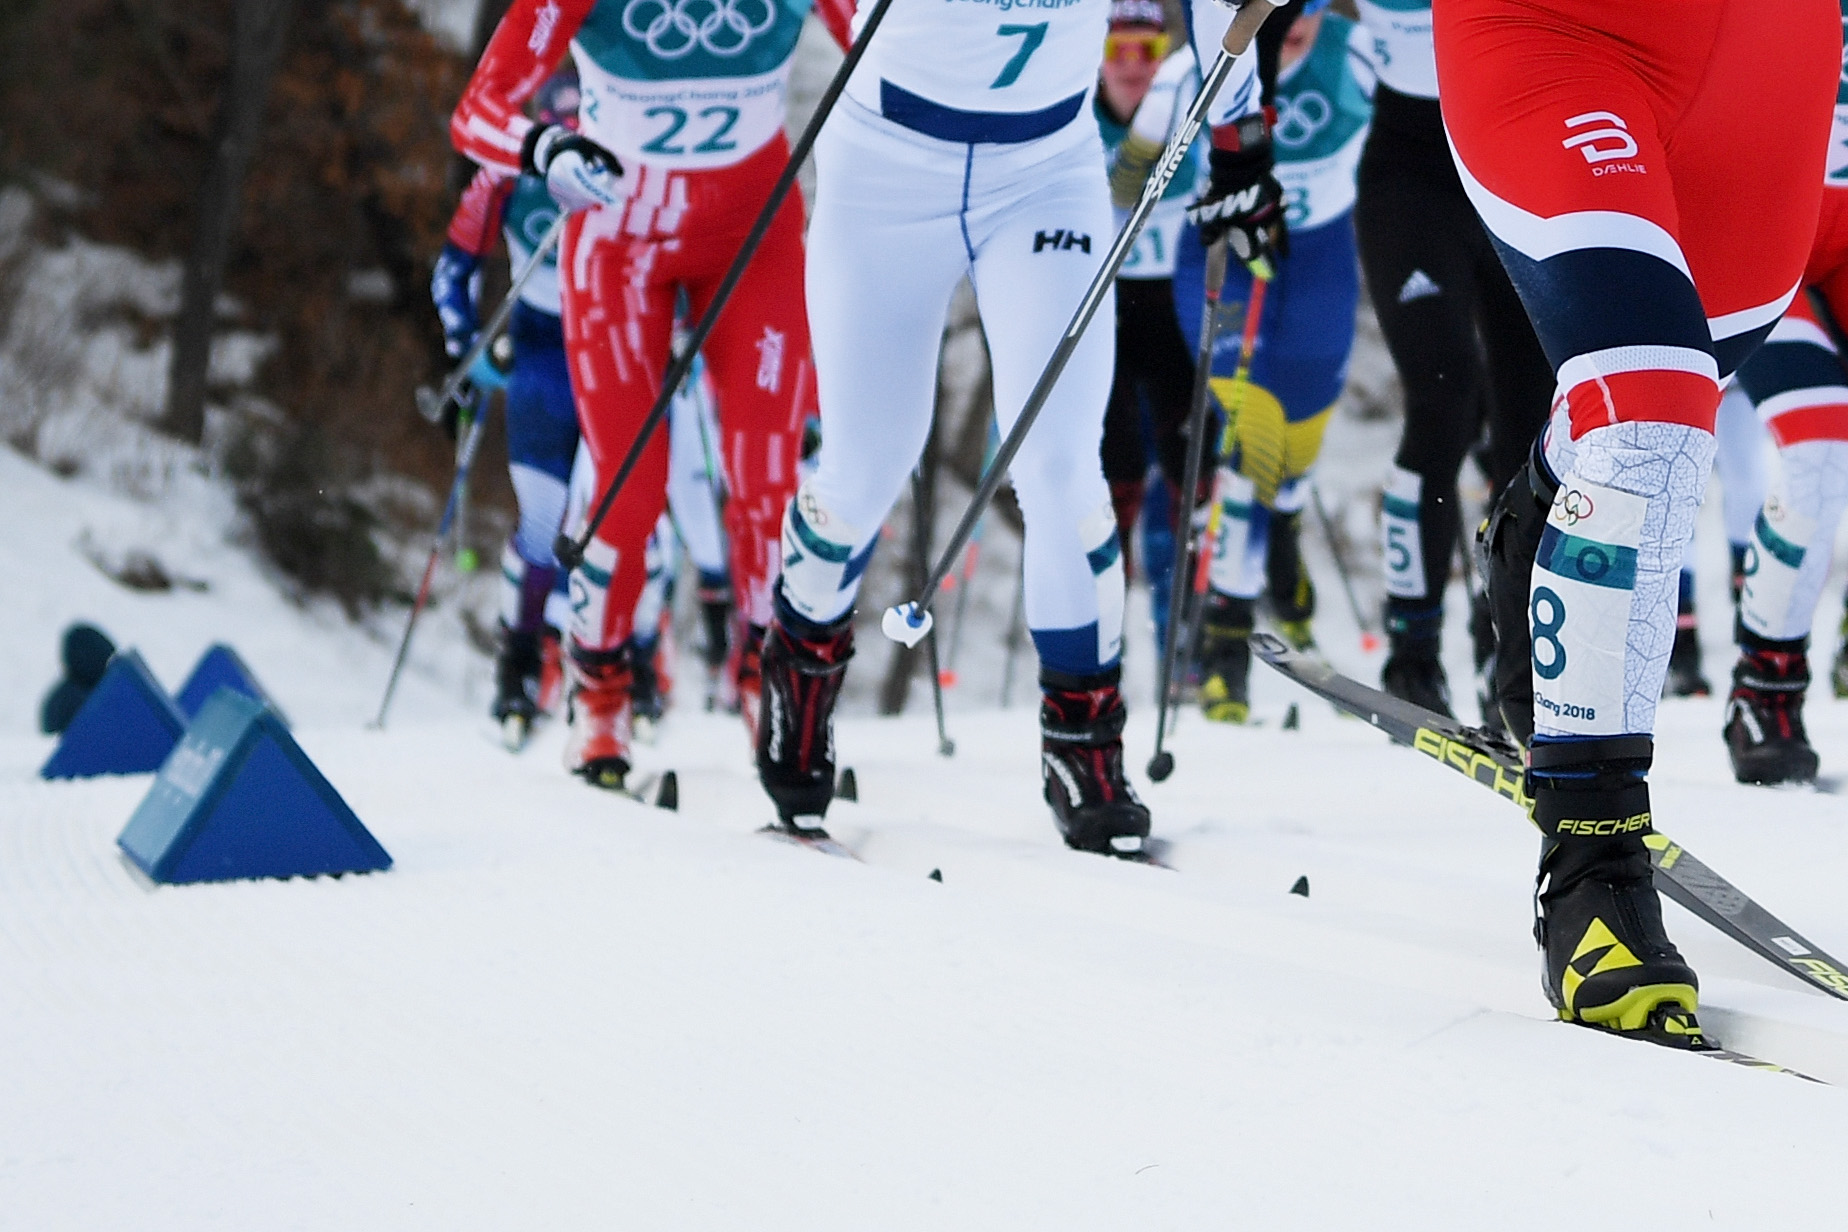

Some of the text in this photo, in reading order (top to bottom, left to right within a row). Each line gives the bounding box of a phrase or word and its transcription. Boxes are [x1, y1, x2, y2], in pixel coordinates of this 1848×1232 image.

[988, 21, 1050, 90] 7
[640, 105, 741, 155] 22
[1591, 163, 1647, 177] DÆHLIE
[1032, 229, 1092, 254] HH
[1531, 585, 1567, 680] 8
[1563, 703, 1596, 720] 2018
[1413, 726, 1537, 818] FISCH
[1556, 812, 1651, 836] FISCHER
